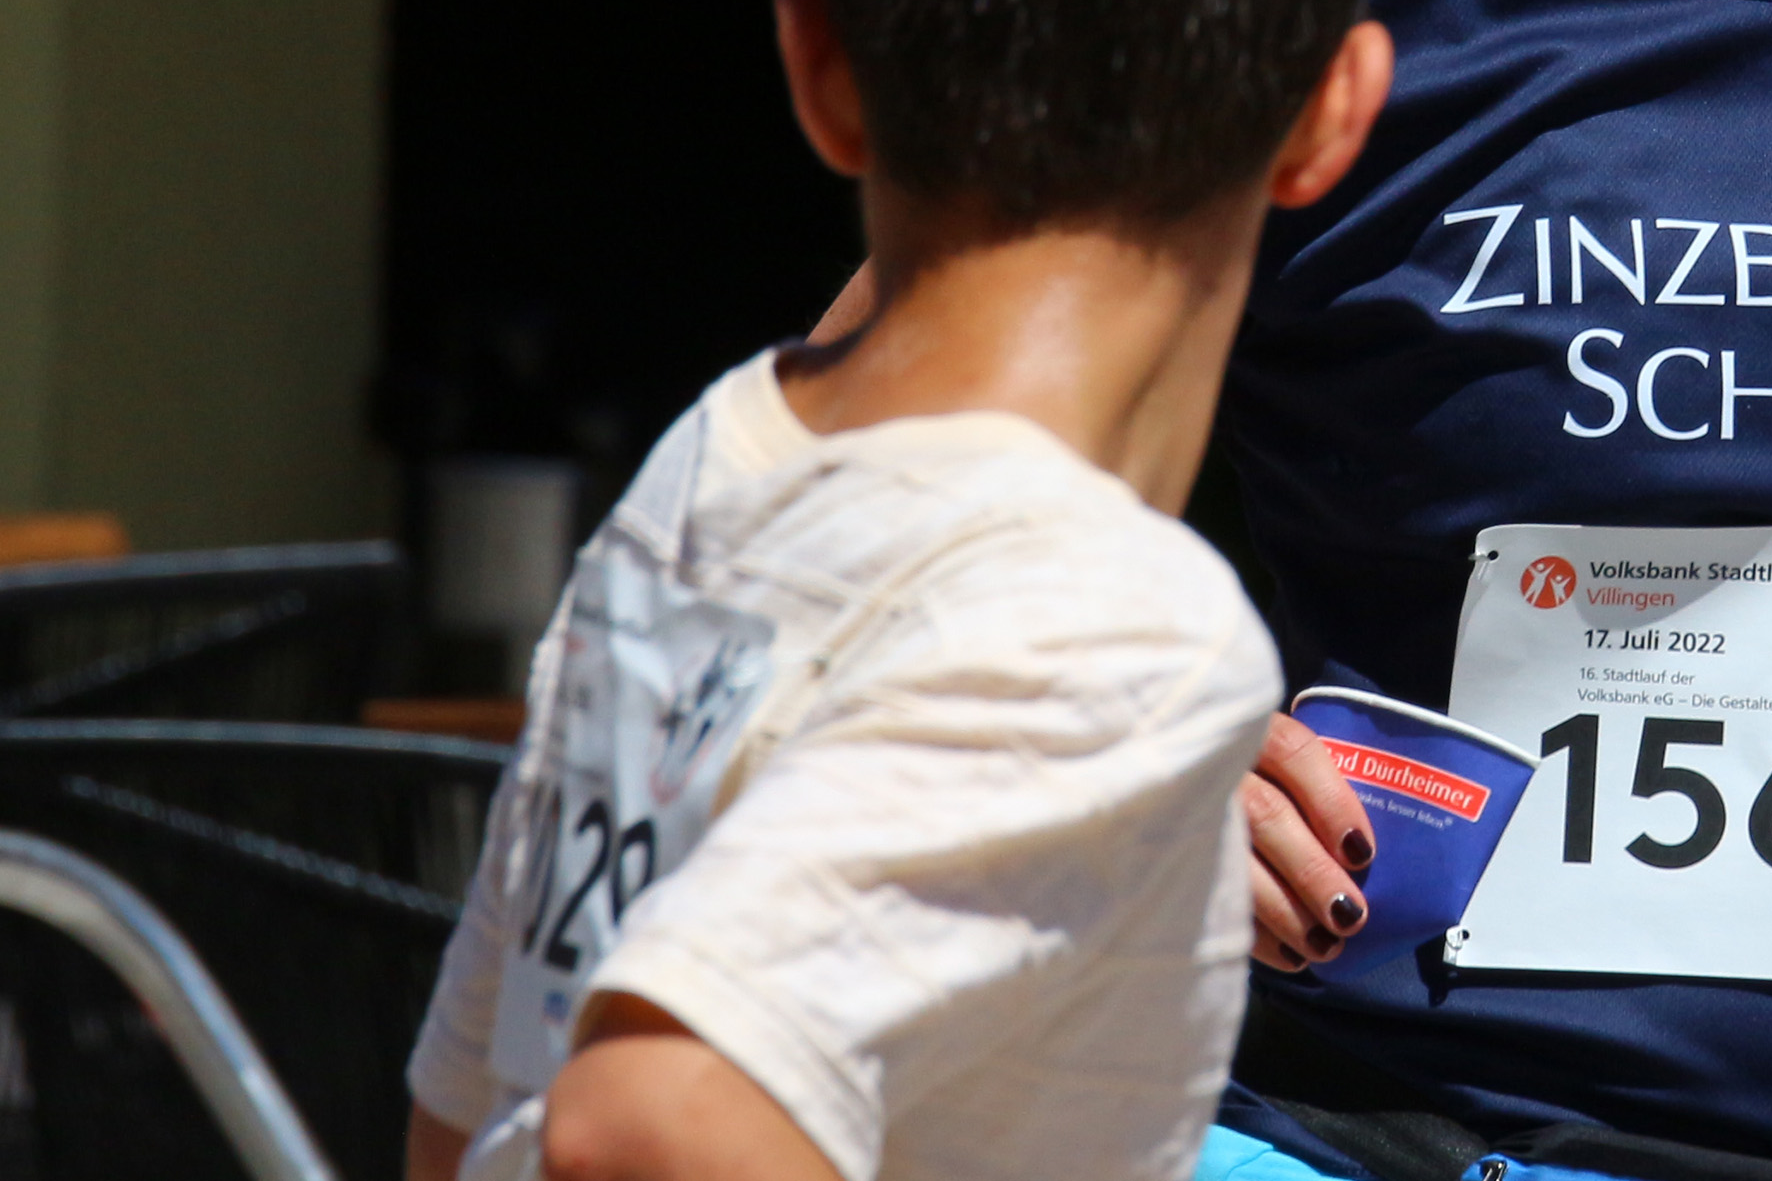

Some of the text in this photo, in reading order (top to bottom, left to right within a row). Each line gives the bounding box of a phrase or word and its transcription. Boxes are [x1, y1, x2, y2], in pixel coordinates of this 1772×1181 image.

[1590, 560, 1700, 581] Volksbank
[1586, 587, 1675, 611] Villingen
[1584, 629, 1726, 654] 17. Juli 2022
[1579, 667, 1695, 686] 16. Stadtlauf der
[1577, 687, 1649, 706] Volksbank
[1654, 692, 1674, 706] eG
[1691, 693, 1715, 709] Die
[1362, 756, 1474, 809] Dürrheimer
